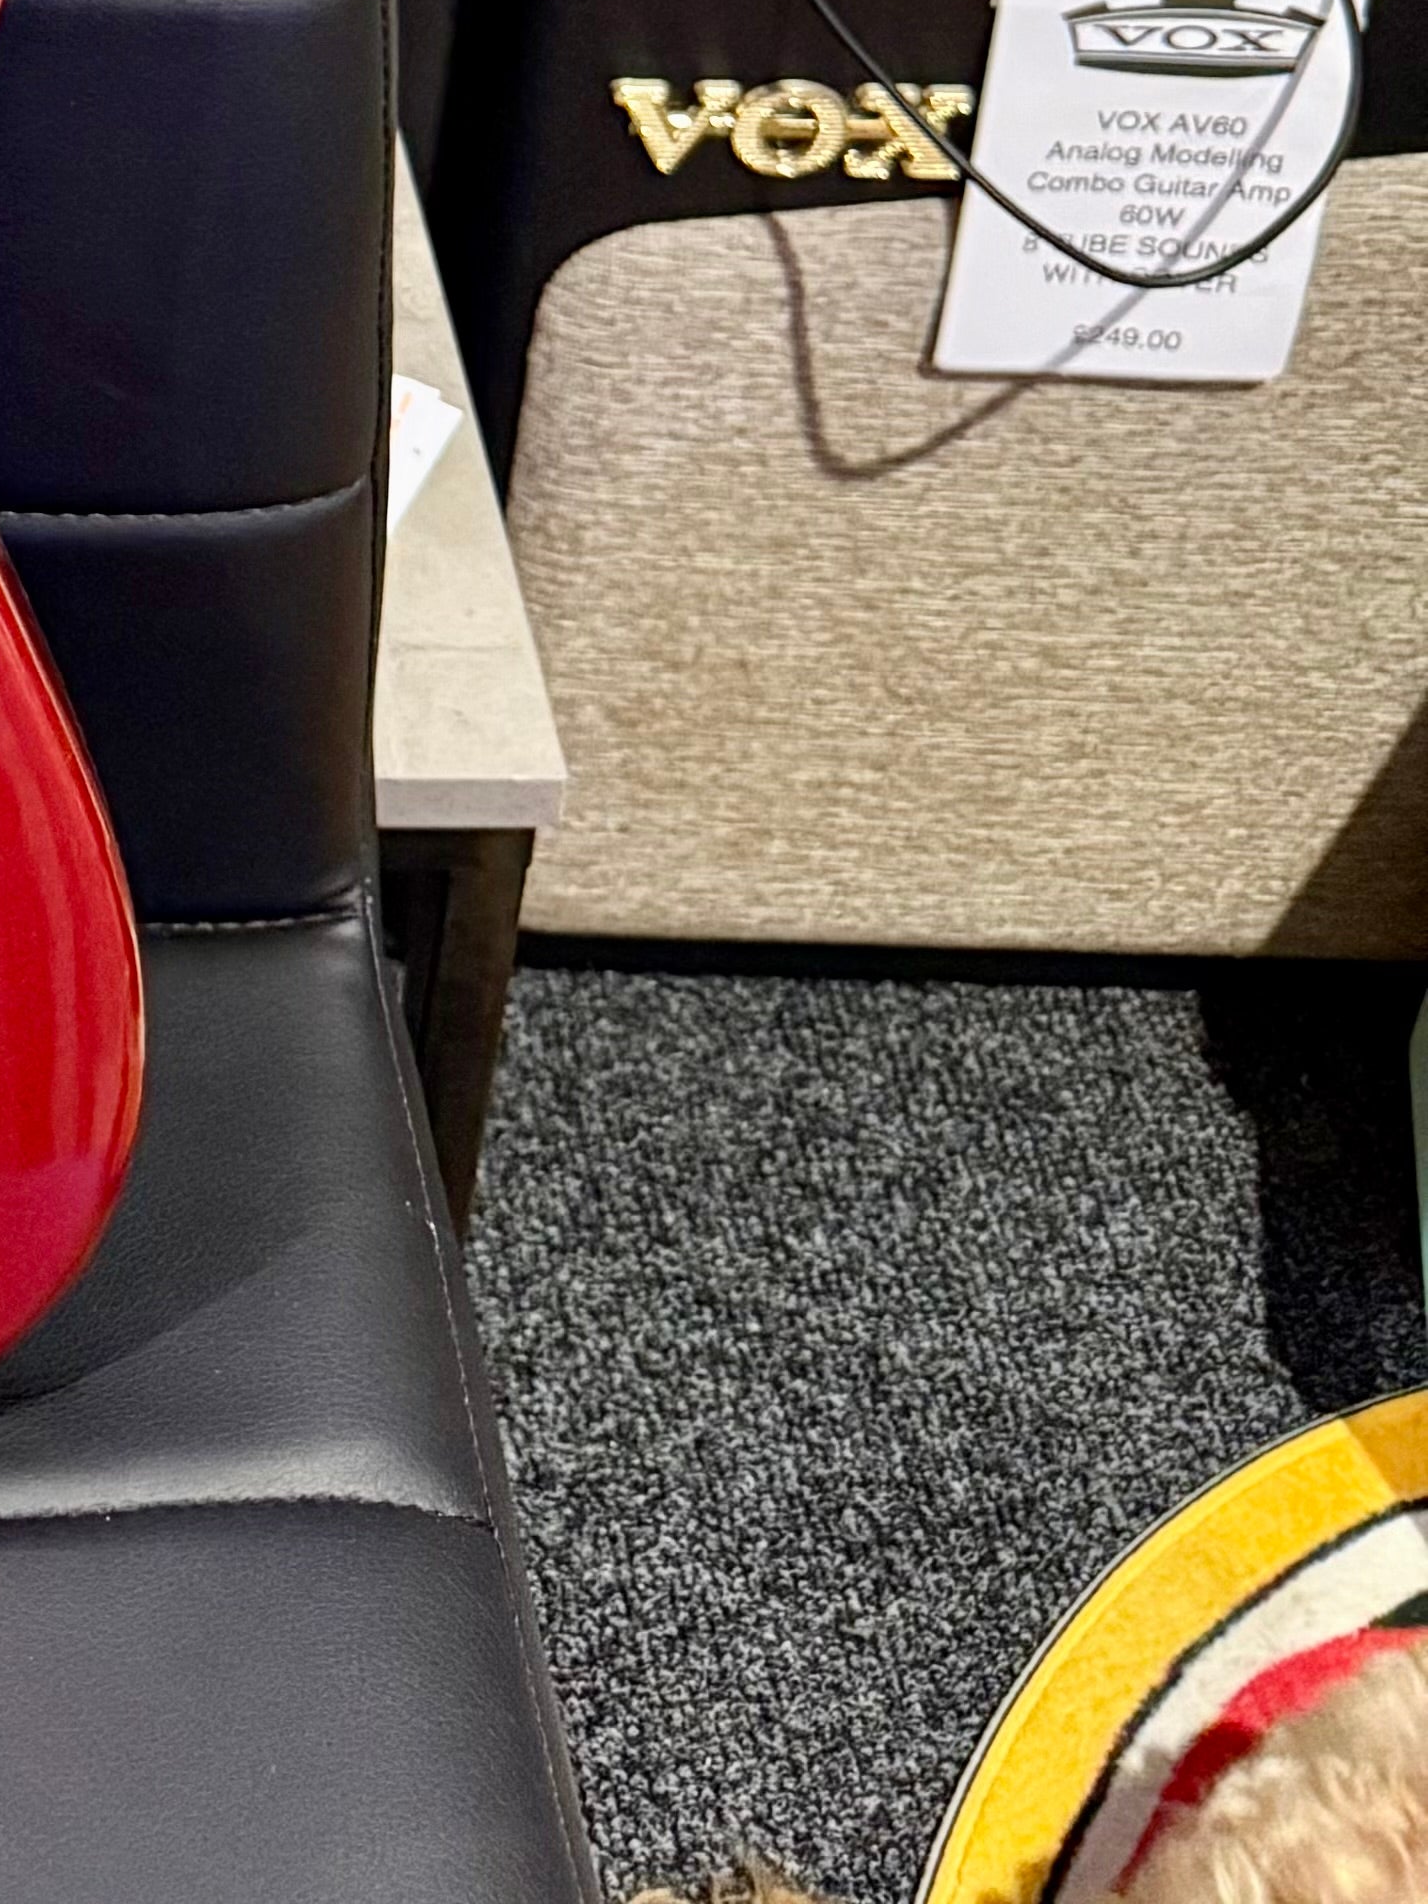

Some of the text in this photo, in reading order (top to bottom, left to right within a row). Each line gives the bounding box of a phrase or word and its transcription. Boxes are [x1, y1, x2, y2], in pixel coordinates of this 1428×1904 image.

[1099, 21, 1291, 55] VOX
[610, 76, 976, 181] VOX
[1097, 109, 1249, 137] VOX AV60
[1045, 140, 1285, 175] Analog Modelling
[1026, 170, 1292, 206] Combo Guitar Amp
[1119, 204, 1186, 228] 60W
[1136, 235, 1269, 265] SOUNS
[1072, 323, 1183, 351] £249.00
